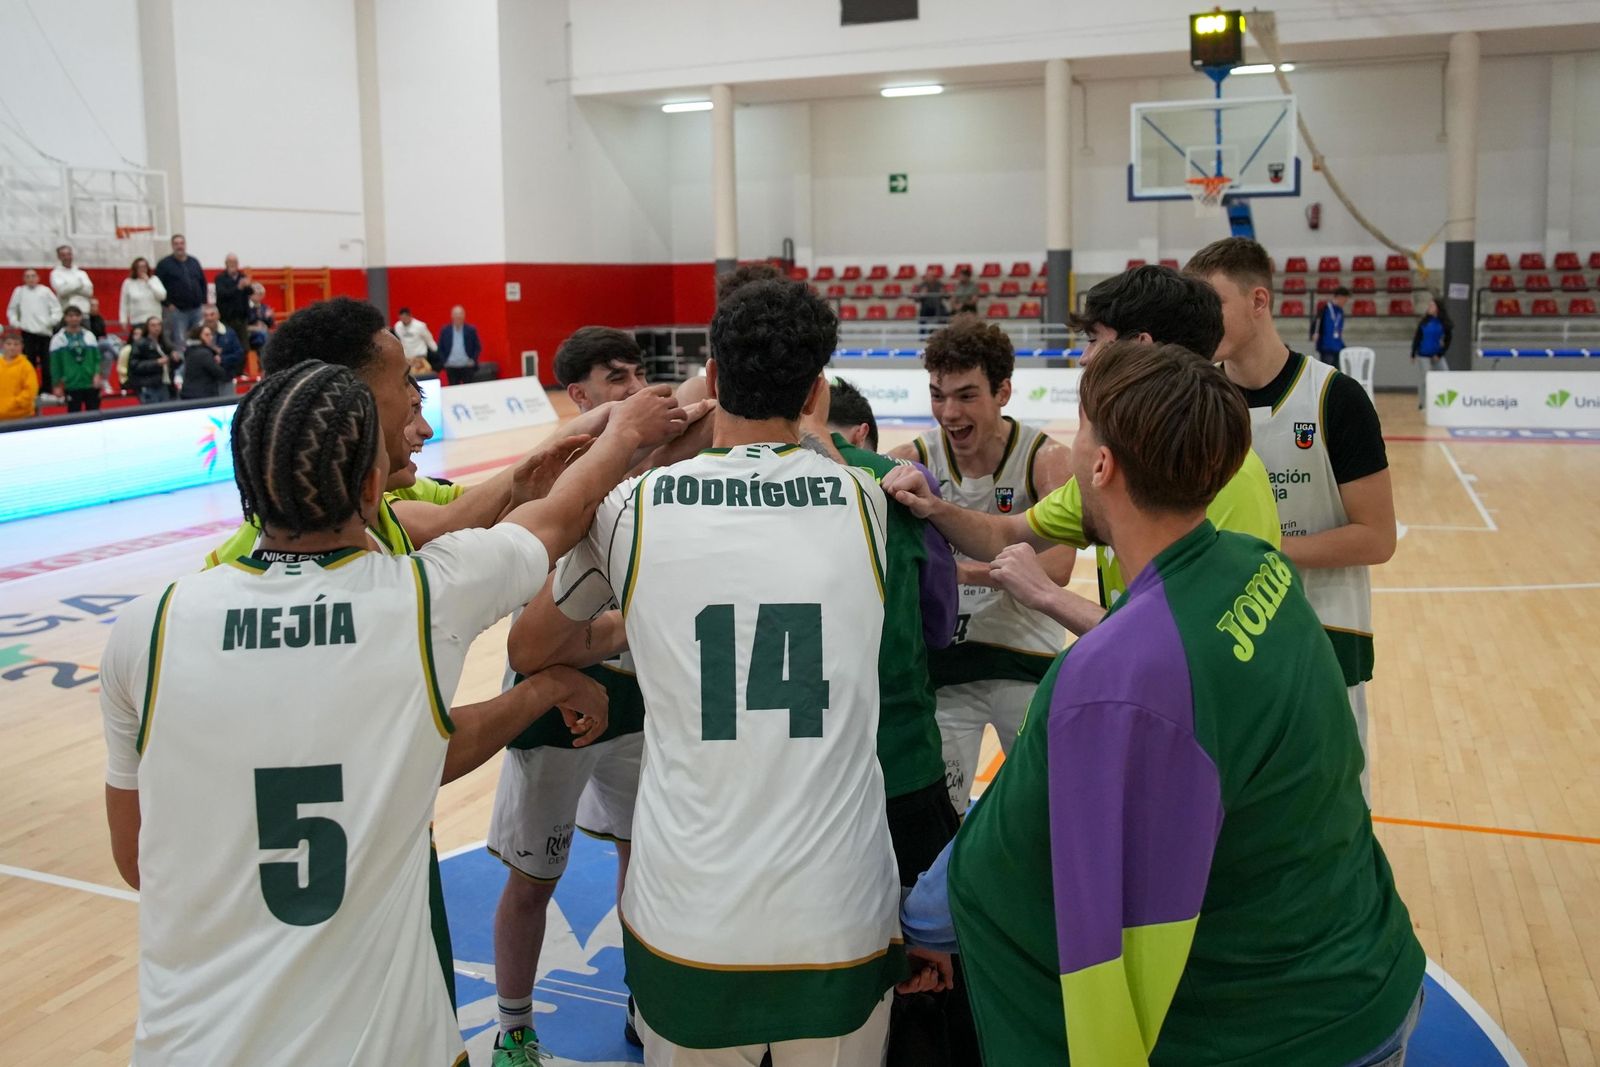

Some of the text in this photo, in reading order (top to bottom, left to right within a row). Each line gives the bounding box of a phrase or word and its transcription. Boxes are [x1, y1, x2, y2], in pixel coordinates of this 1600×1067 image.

[1462, 394, 1518, 410] Unicaja
[1295, 423, 1314, 431] LIGA
[1266, 469, 1311, 483] ación
[653, 472, 847, 508] RODRÍGUEZ
[996, 488, 1012, 496] LIGA
[261, 551, 296, 562] NIKE
[963, 588, 976, 596] de
[222, 593, 357, 651] MEJÍA
[695, 603, 830, 741] 14
[254, 763, 348, 927] 5
